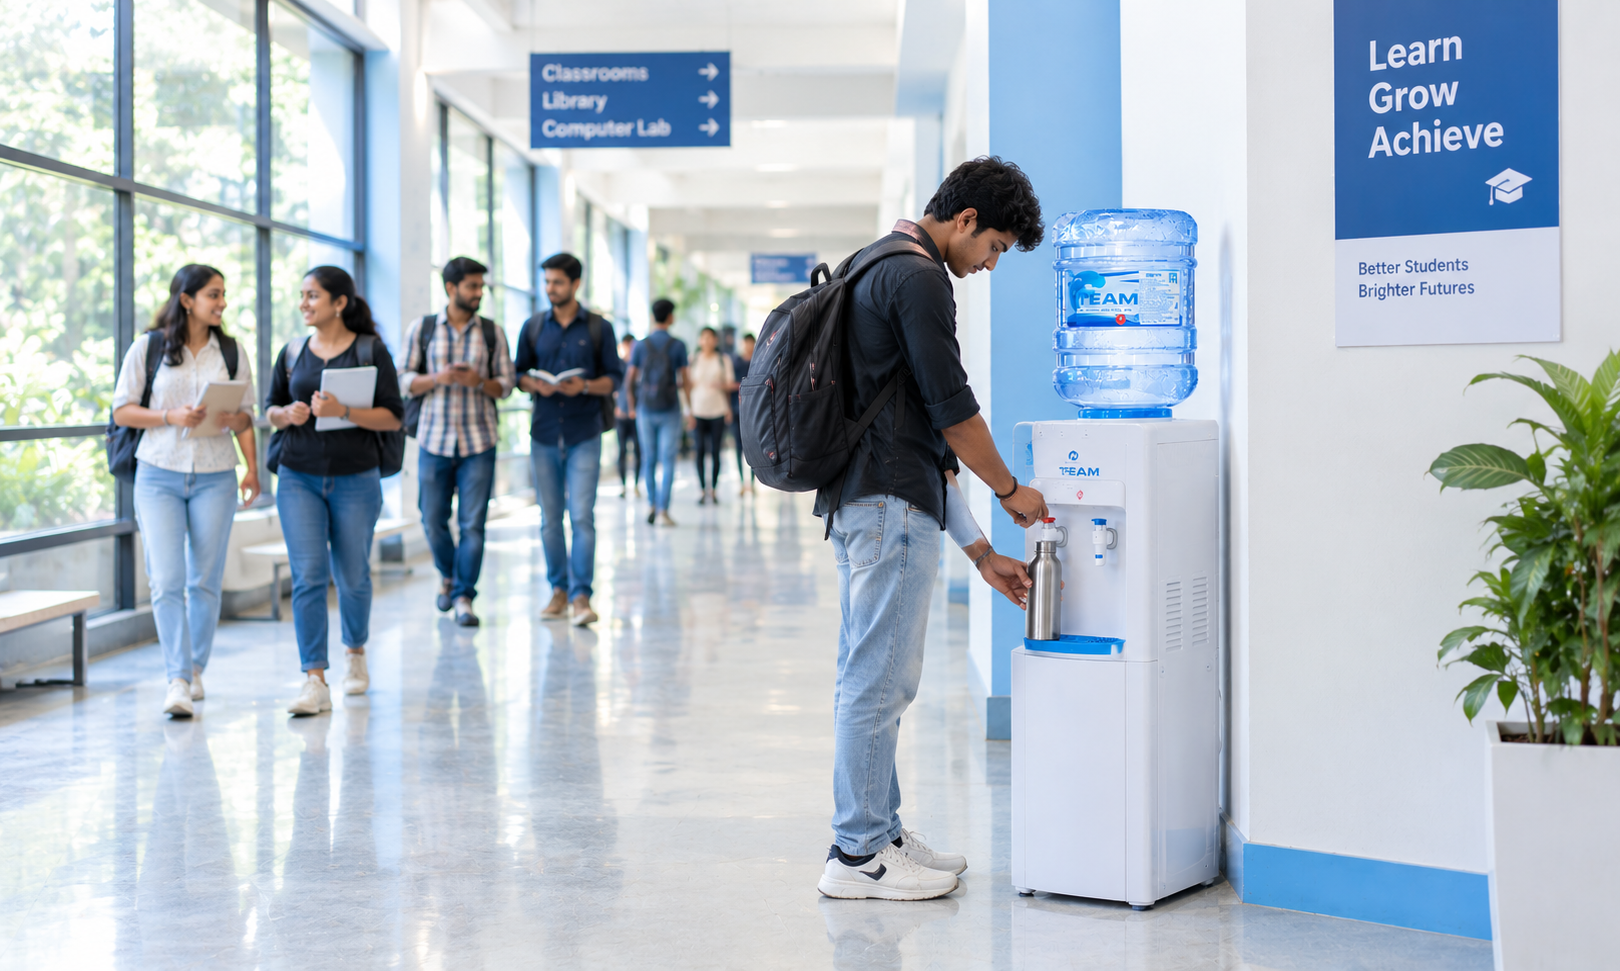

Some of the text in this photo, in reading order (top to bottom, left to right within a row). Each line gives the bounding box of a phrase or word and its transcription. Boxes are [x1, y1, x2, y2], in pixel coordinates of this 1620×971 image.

[1369, 35, 1463, 71] Learn
[542, 63, 649, 82] Classrooms
[542, 90, 608, 113] Library
[1369, 81, 1459, 114] Grow
[542, 118, 672, 140] Computer Lab
[1368, 119, 1504, 158] Achieve
[1358, 258, 1469, 275] Better Students
[1079, 293, 1138, 306] TEAM
[1358, 281, 1475, 301] Brighter Futures
